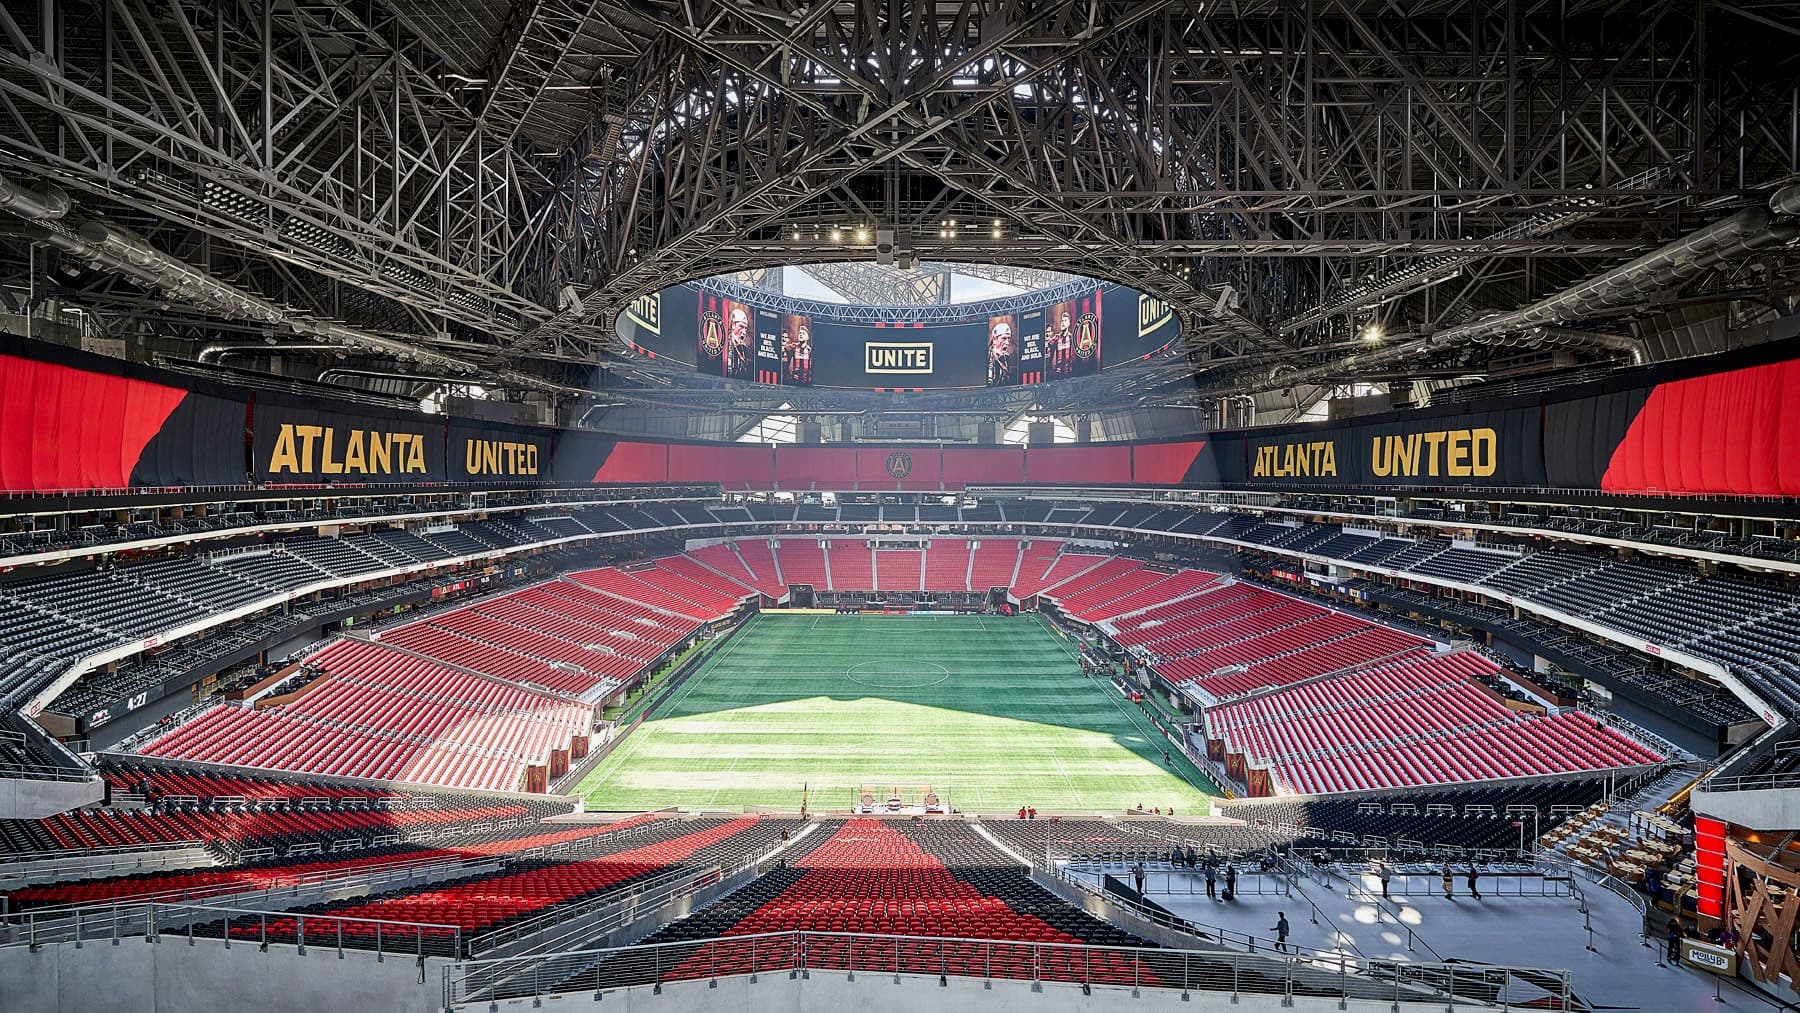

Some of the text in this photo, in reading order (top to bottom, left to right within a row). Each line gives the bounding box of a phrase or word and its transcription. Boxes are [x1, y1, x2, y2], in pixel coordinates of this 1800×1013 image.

[871, 349, 927, 367] UNITE
[268, 423, 538, 475] ATLANTA UNITED
[1253, 427, 1497, 477] ATLANTA UNITED
[127, 691, 148, 710] 4:27
